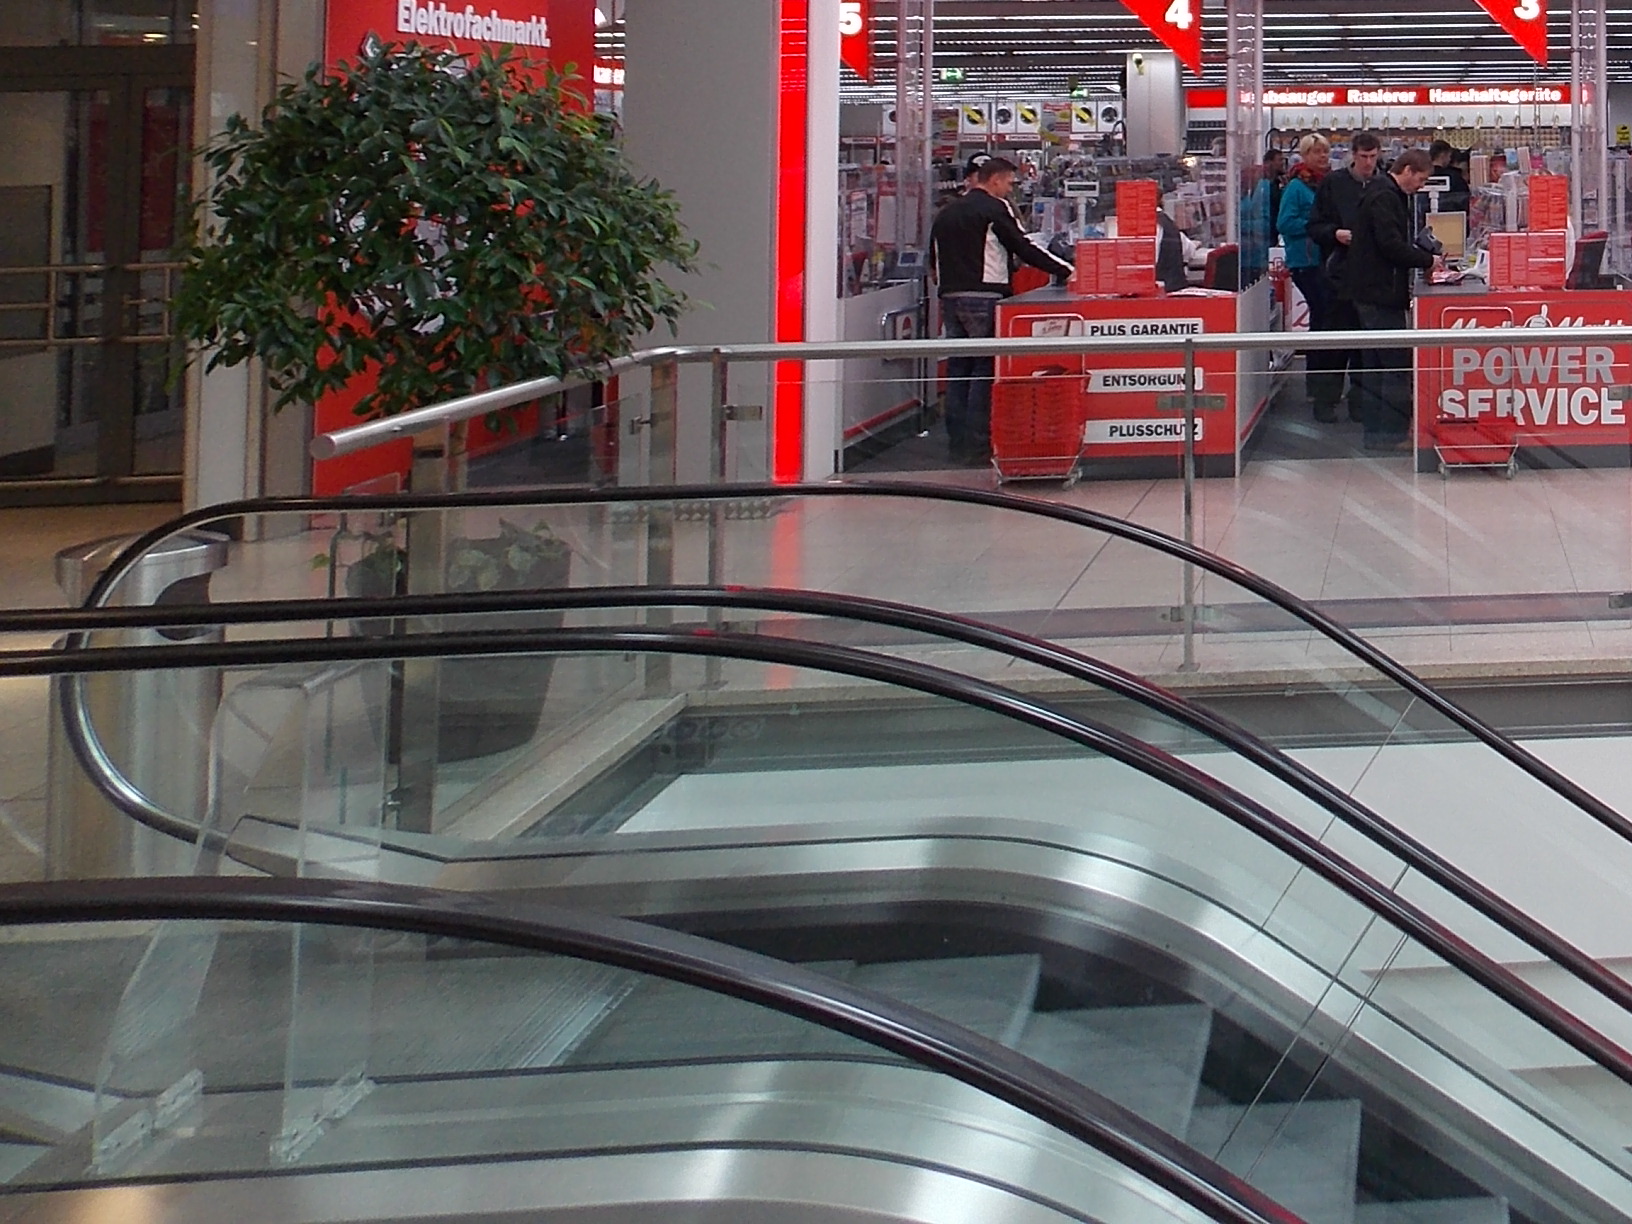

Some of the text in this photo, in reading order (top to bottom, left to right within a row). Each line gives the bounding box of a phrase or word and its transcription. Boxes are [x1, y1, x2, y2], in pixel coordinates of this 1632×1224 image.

[839, 2, 863, 35] 5
[1347, 89, 1416, 104] Rasierer
[1429, 87, 1562, 104] Haushaltsgeräte
[1090, 323, 1199, 336] PLUS GARANTIE
[1452, 346, 1615, 385] POWER
[1102, 374, 1196, 387] ENTSORGUN
[1438, 387, 1626, 425] SERVICE
